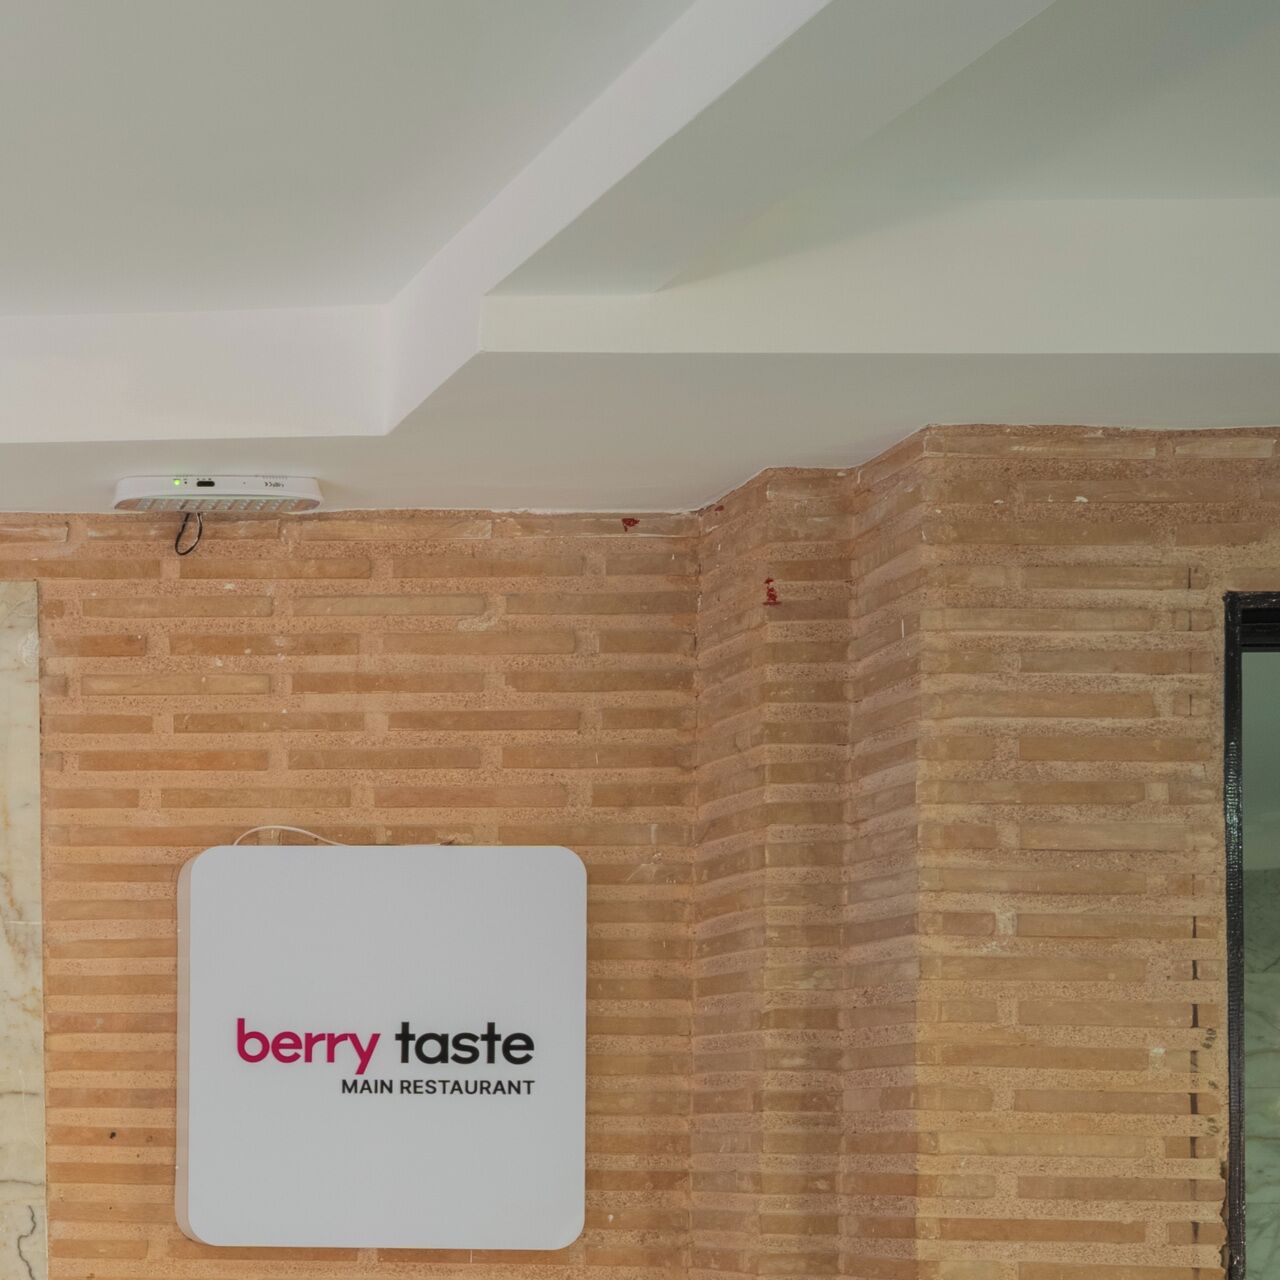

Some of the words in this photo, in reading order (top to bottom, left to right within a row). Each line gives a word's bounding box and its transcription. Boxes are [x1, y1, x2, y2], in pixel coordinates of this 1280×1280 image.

[236, 1017, 381, 1076] berry
[394, 1021, 535, 1066] taste
[341, 1079, 393, 1095] MAIN
[399, 1079, 536, 1095] RESTAURANT
